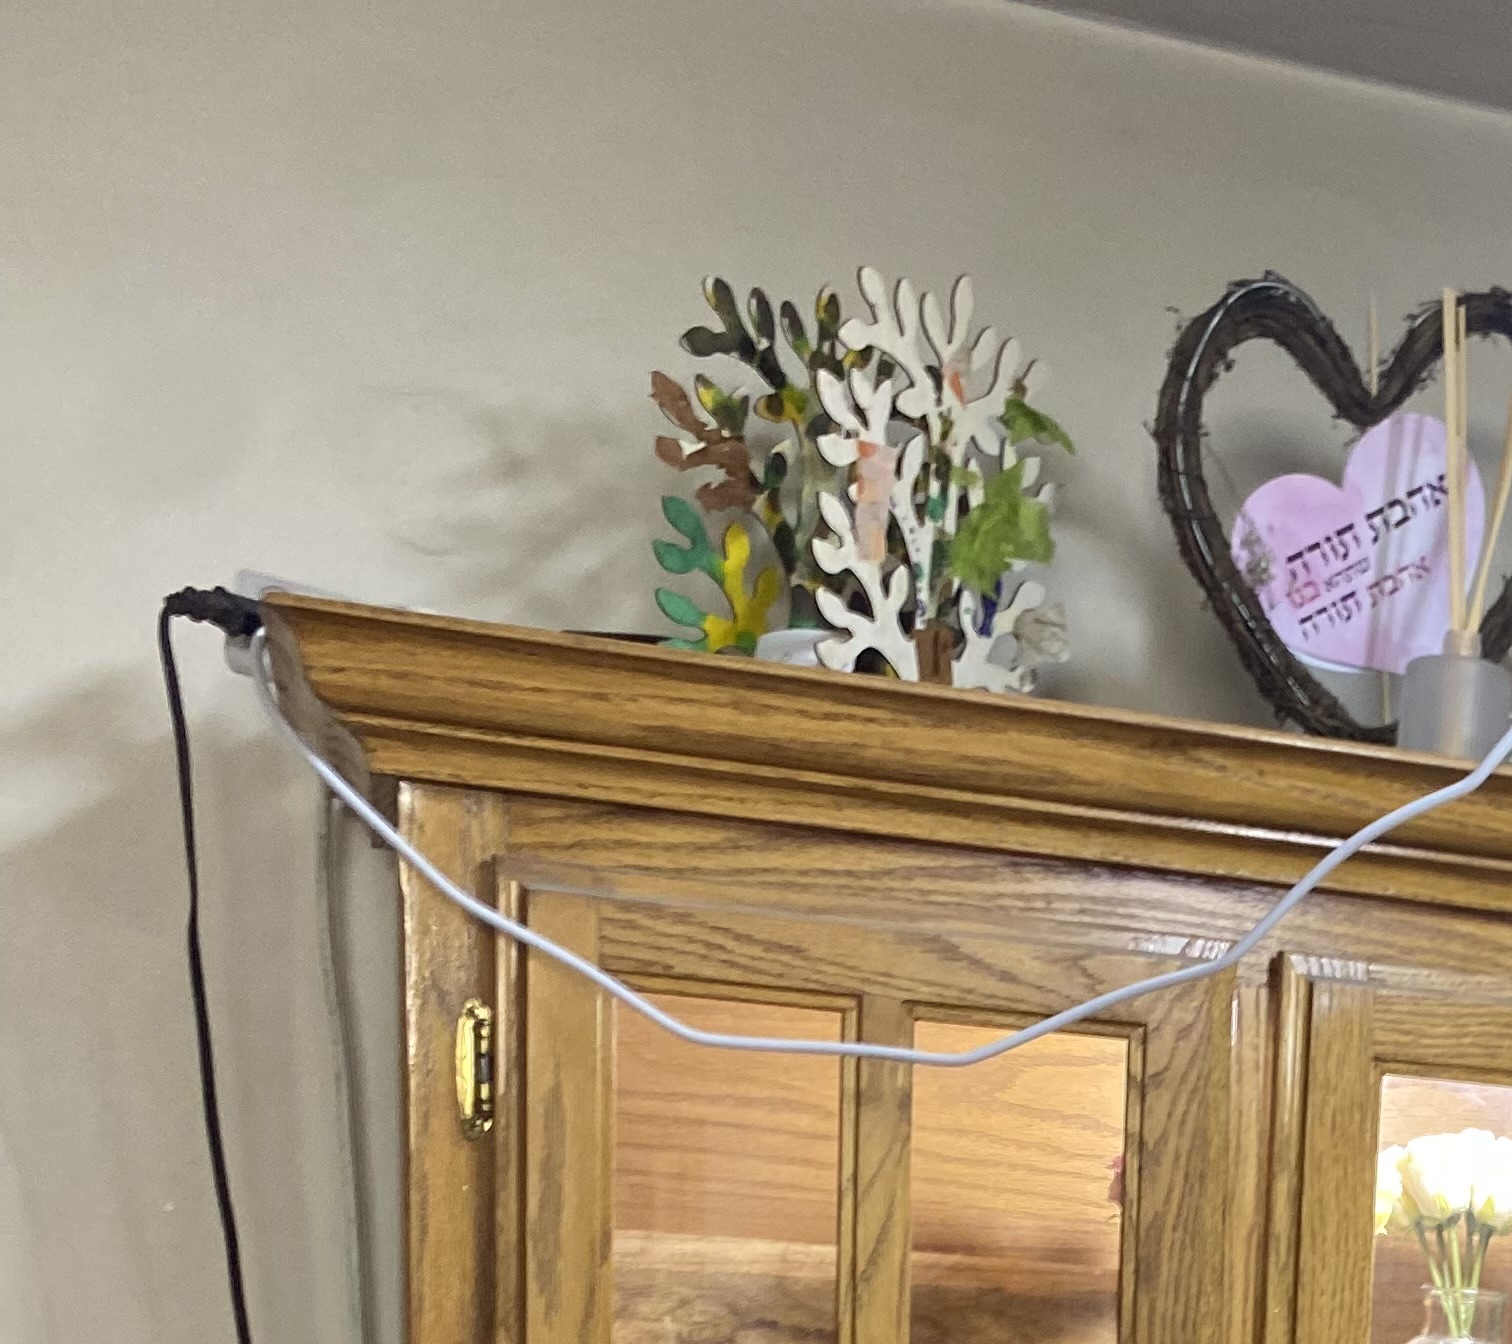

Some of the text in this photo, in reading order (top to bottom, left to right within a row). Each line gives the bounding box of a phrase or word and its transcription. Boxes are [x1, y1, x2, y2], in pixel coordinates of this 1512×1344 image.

[1286, 474, 1448, 581] אהבת תורה
[1298, 556, 1431, 641] אהבת תורה
